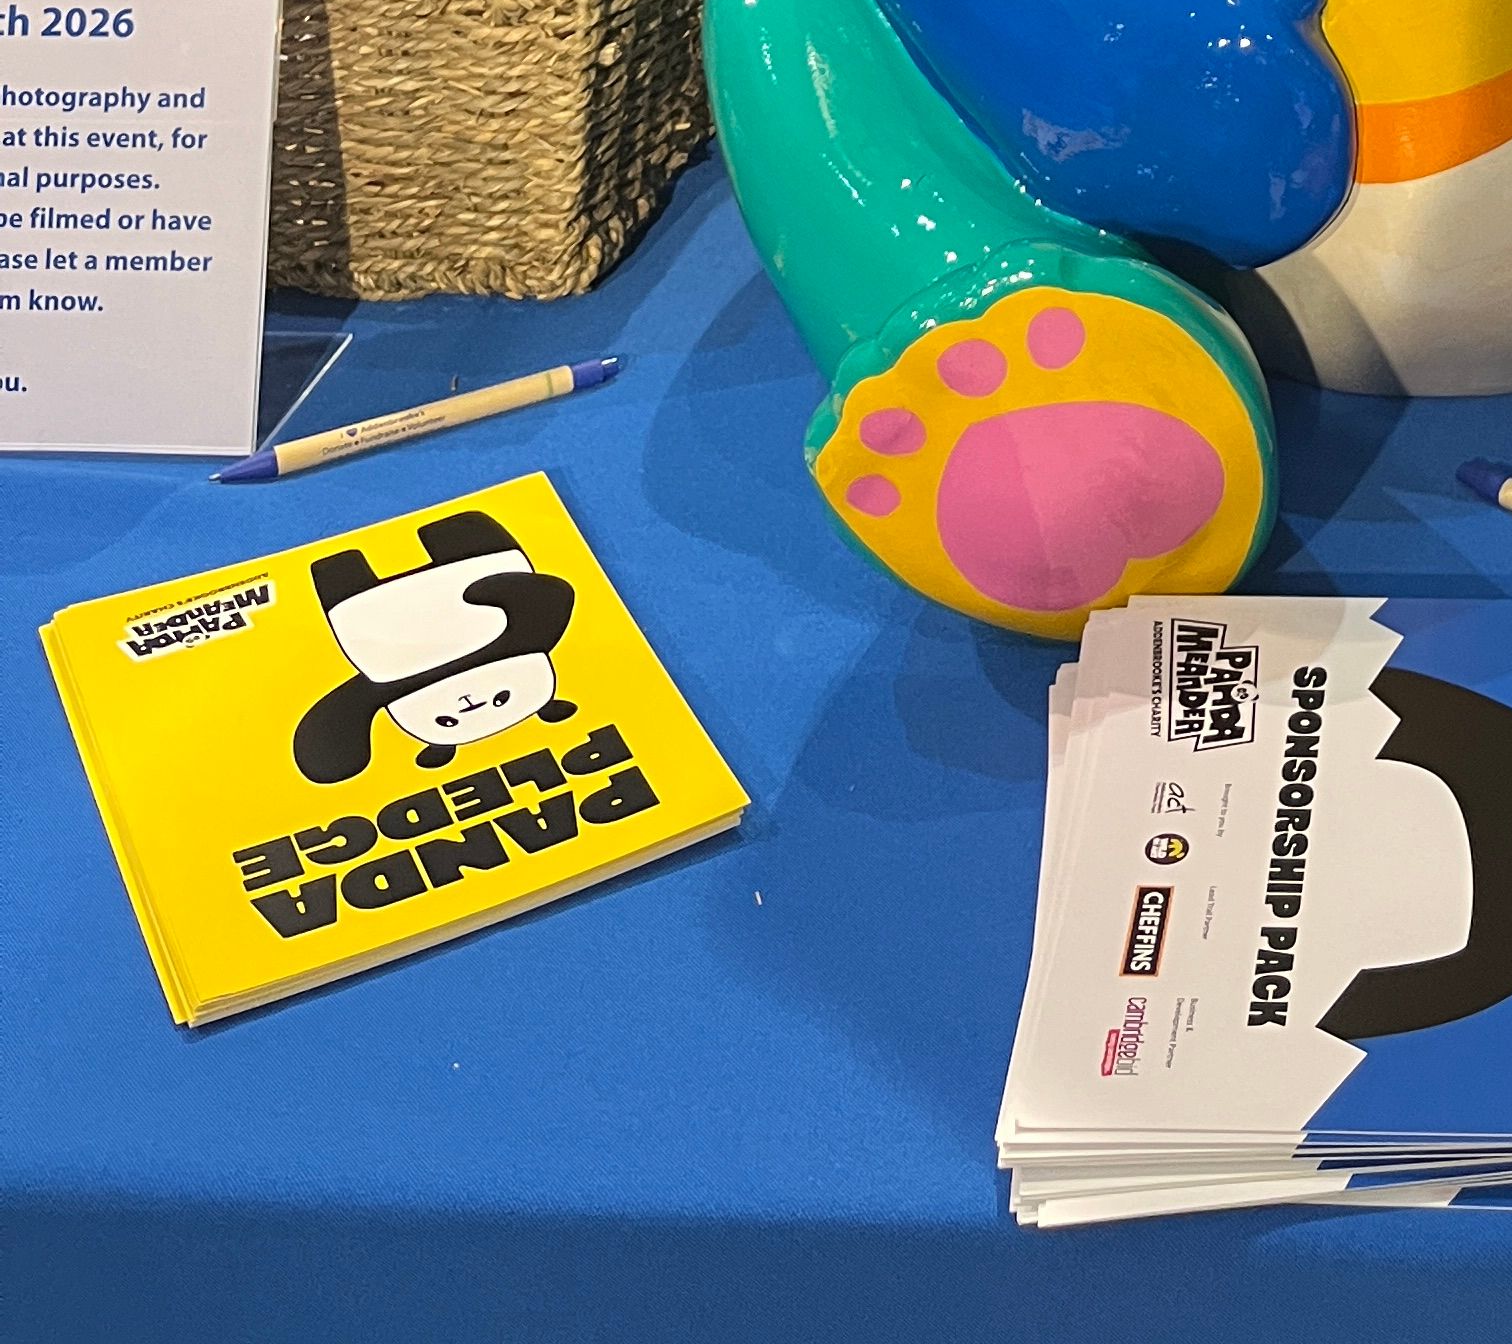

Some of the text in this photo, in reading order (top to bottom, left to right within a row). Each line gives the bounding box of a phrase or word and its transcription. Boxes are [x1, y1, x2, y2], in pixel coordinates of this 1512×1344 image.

[41, 7, 134, 38] 2026
[157, 87, 206, 108] and
[3, 126, 208, 151] at this event, for
[36, 172, 160, 193] purposes.
[30, 206, 110, 229] filmed
[118, 214, 145, 230] or
[151, 208, 212, 230] have
[45, 248, 78, 270] let
[84, 254, 97, 270] a
[105, 250, 213, 272] member
[29, 289, 103, 311] know.
[132, 584, 270, 636] MEANDER
[127, 612, 247, 656] PANDA
[1174, 625, 1219, 735] MEANDER
[1202, 651, 1252, 744] PANDA
[233, 723, 632, 890] PLEDGE
[1165, 782, 1195, 813] act
[250, 766, 660, 939] PANDA
[1247, 666, 1328, 1026] SPONSORSHIP PACK
[1130, 891, 1165, 971] CHEFFINS
